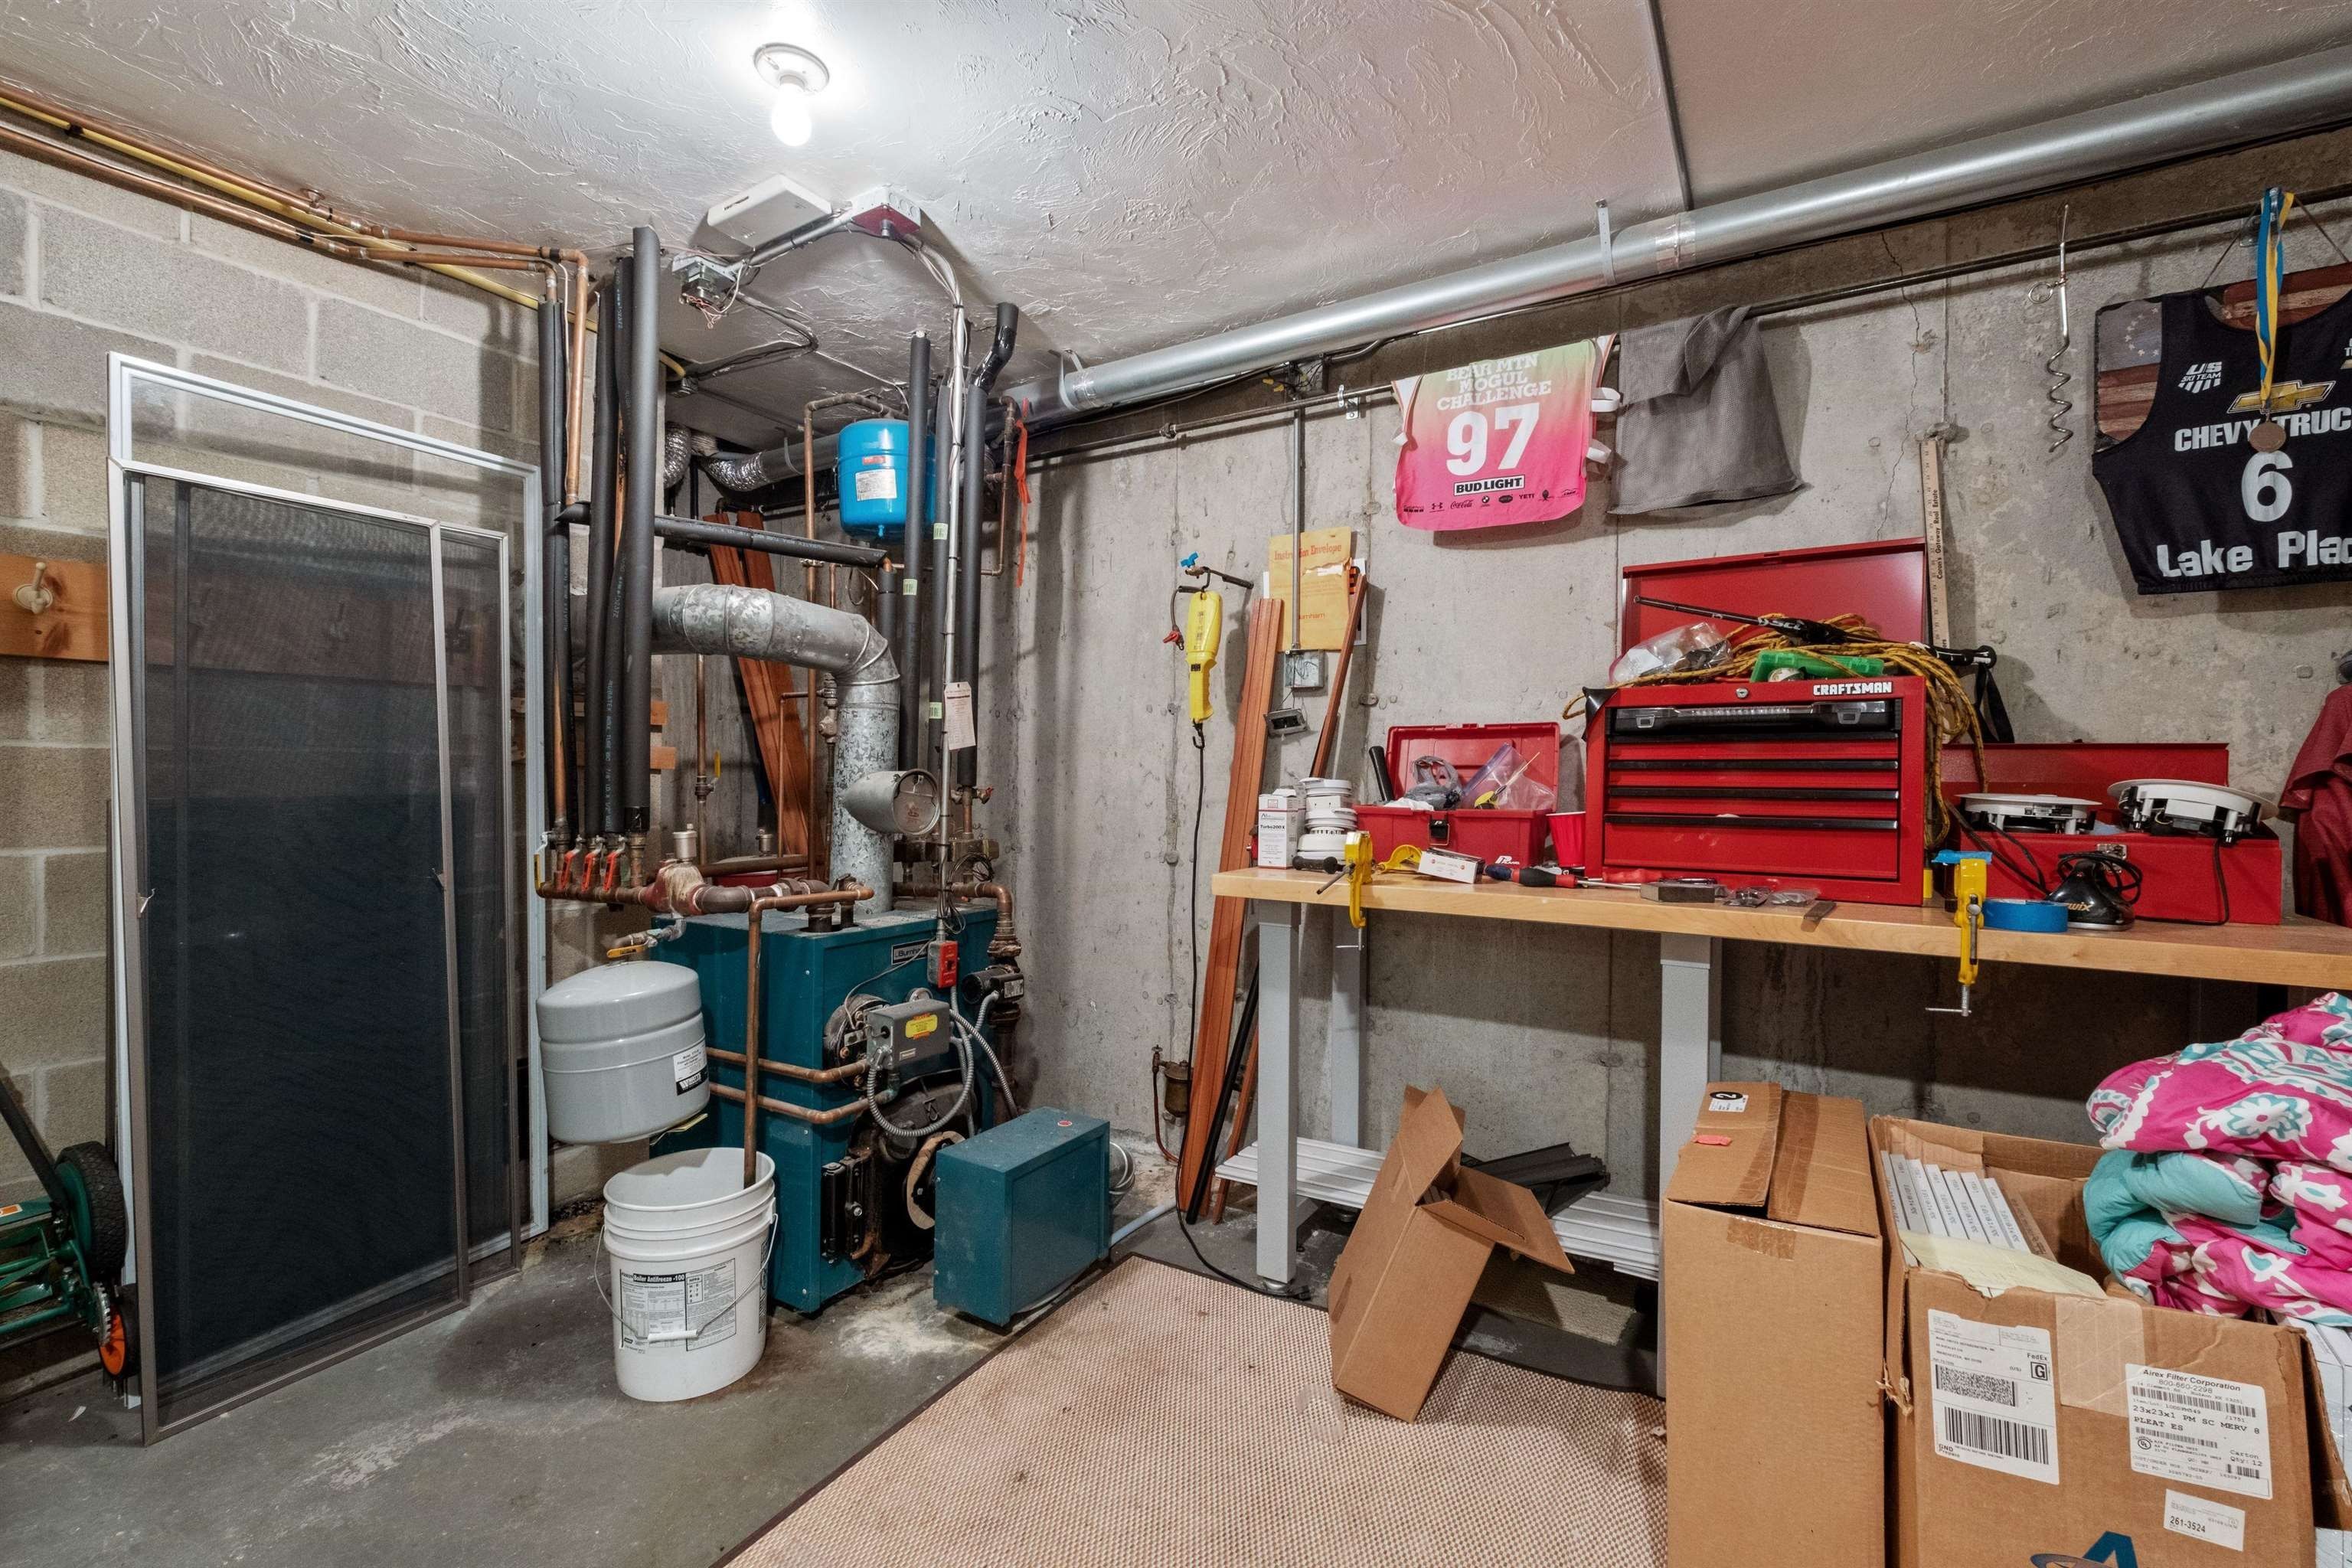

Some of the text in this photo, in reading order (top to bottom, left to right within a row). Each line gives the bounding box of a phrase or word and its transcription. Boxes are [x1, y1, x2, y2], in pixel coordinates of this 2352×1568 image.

[1496, 353, 1539, 372] MTN
[2186, 361, 2222, 375] US
[1459, 371, 1528, 394] MOGUL
[2182, 371, 2222, 382] SKI TEAM
[1436, 380, 1552, 410] CHALLENGE
[1446, 403, 1540, 476] 97
[2174, 418, 2261, 452] CHEVY
[1455, 477, 1522, 494] BUD LIGHT
[2241, 450, 2293, 522] 6
[1274, 543, 1342, 560] Instrion Envelope
[2156, 530, 2352, 577] Lake Plac
[1813, 681, 1892, 695] CRAFTSMAN
[2068, 901, 2094, 911] wix
[2034, 1364, 2046, 1378] G
[2143, 1369, 2241, 1391] Airex Filter Corporation
[2133, 1406, 2175, 1418] 23x23x1
[2220, 1422, 2248, 1432] MERV
[2134, 1416, 2165, 1427] PLEAT
[2230, 1449, 2259, 1459] Carton
[2170, 1516, 2206, 1533] 261-3524
